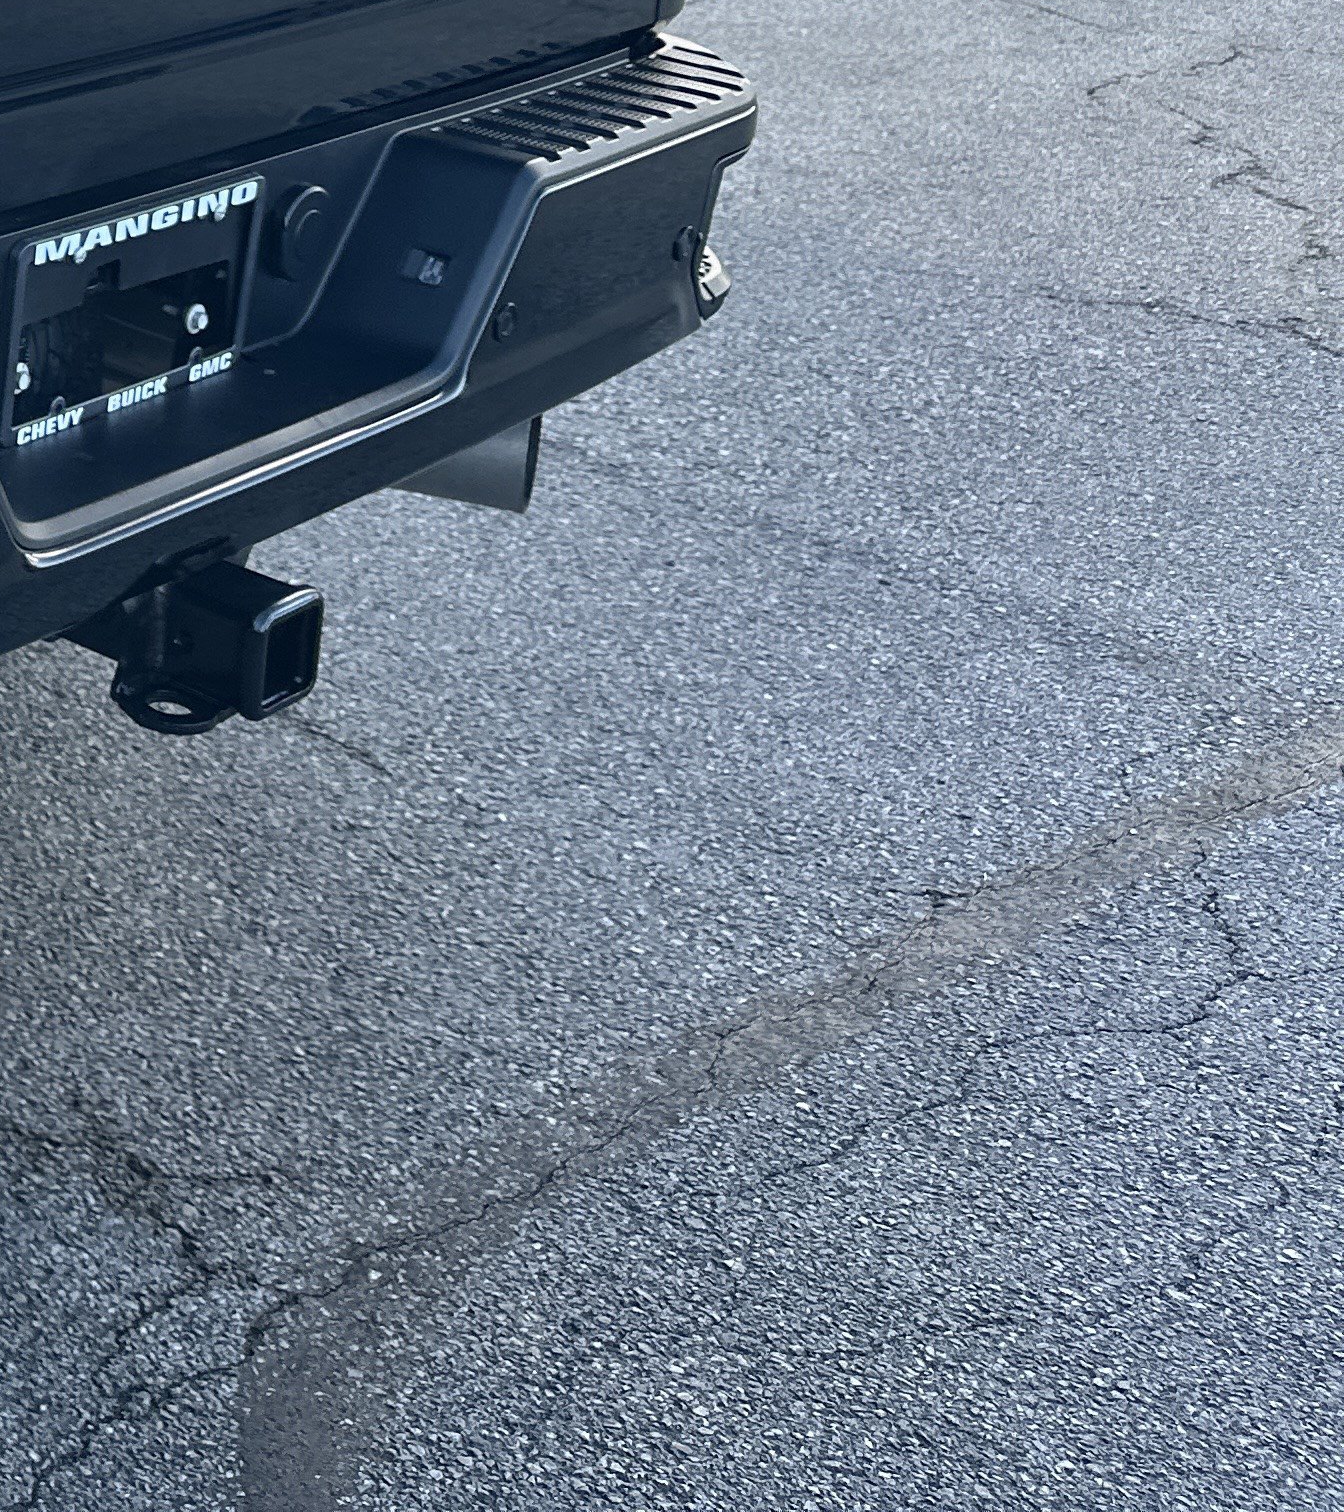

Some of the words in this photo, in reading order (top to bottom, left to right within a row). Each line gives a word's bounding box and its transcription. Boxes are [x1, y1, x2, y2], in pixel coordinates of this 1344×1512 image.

[34, 181, 258, 265] MANGINO
[17, 407, 84, 445] CHEVY
[107, 377, 168, 413] BUICK
[188, 351, 233, 382] GMC
